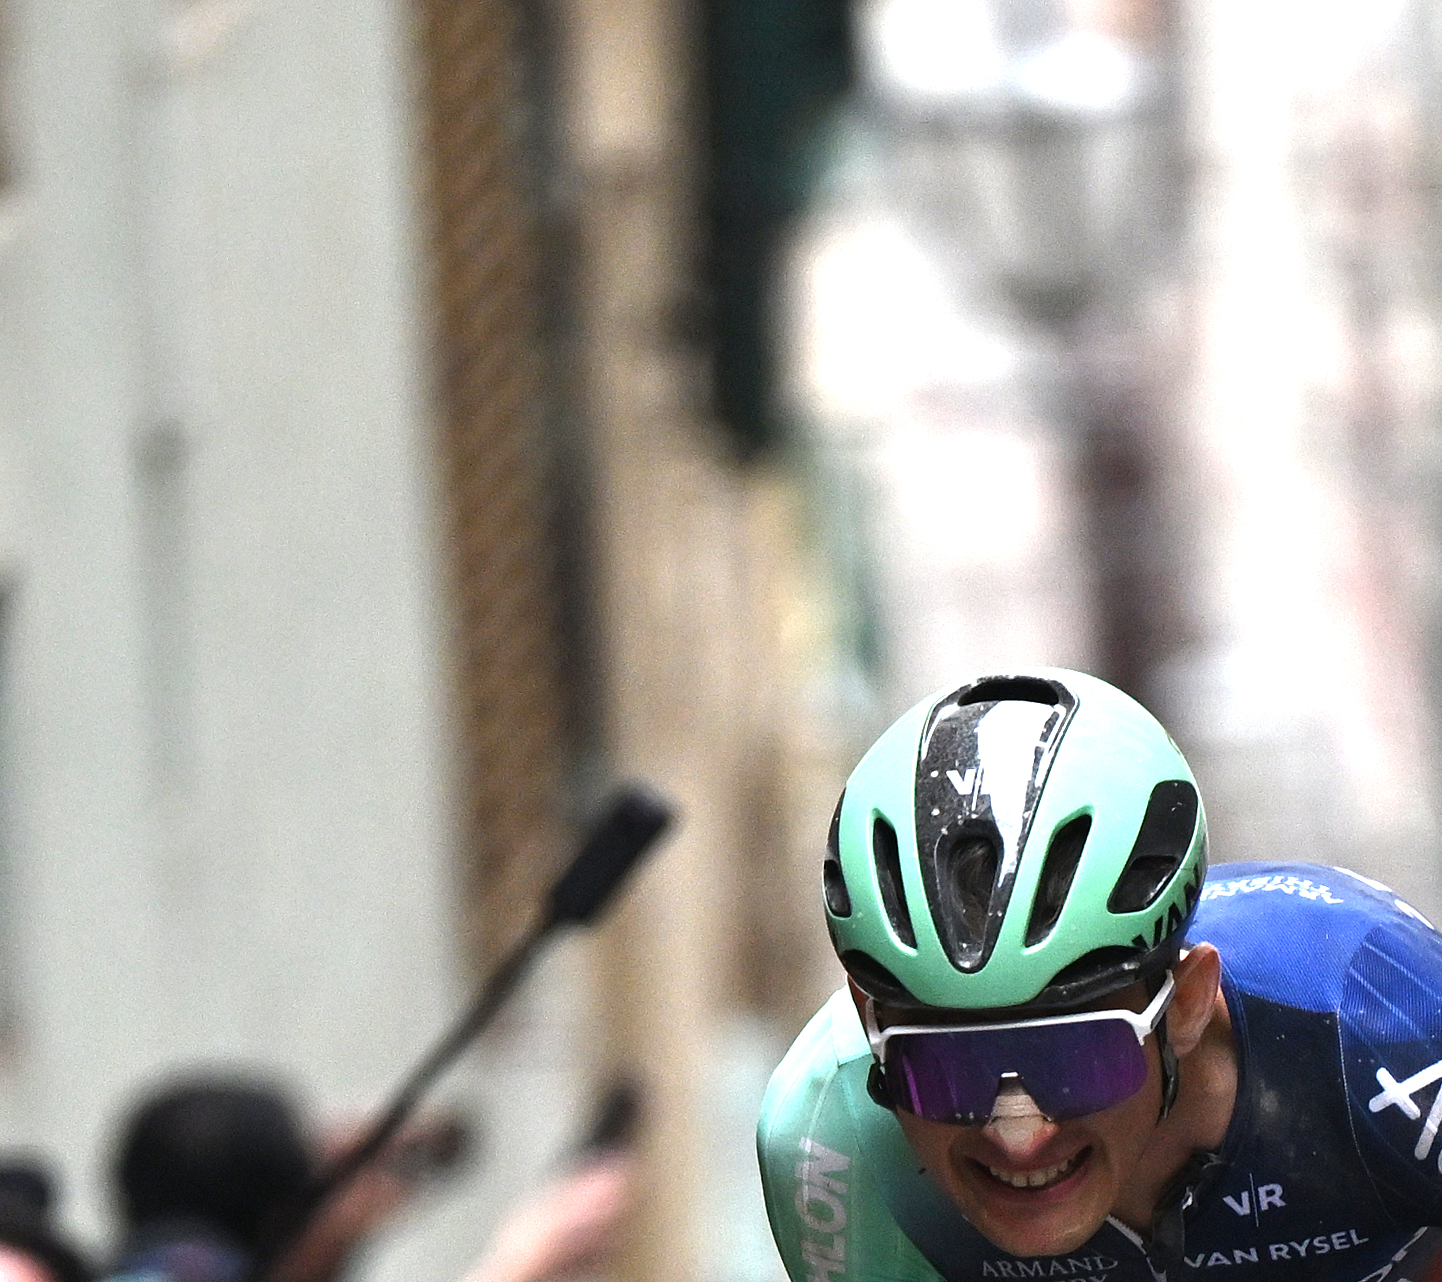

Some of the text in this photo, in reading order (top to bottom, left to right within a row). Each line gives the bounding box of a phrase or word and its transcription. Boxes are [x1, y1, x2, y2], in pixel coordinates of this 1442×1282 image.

[1184, 1228, 1369, 1269] VAN RYSEL
[981, 1256, 1119, 1278] ARMAND
